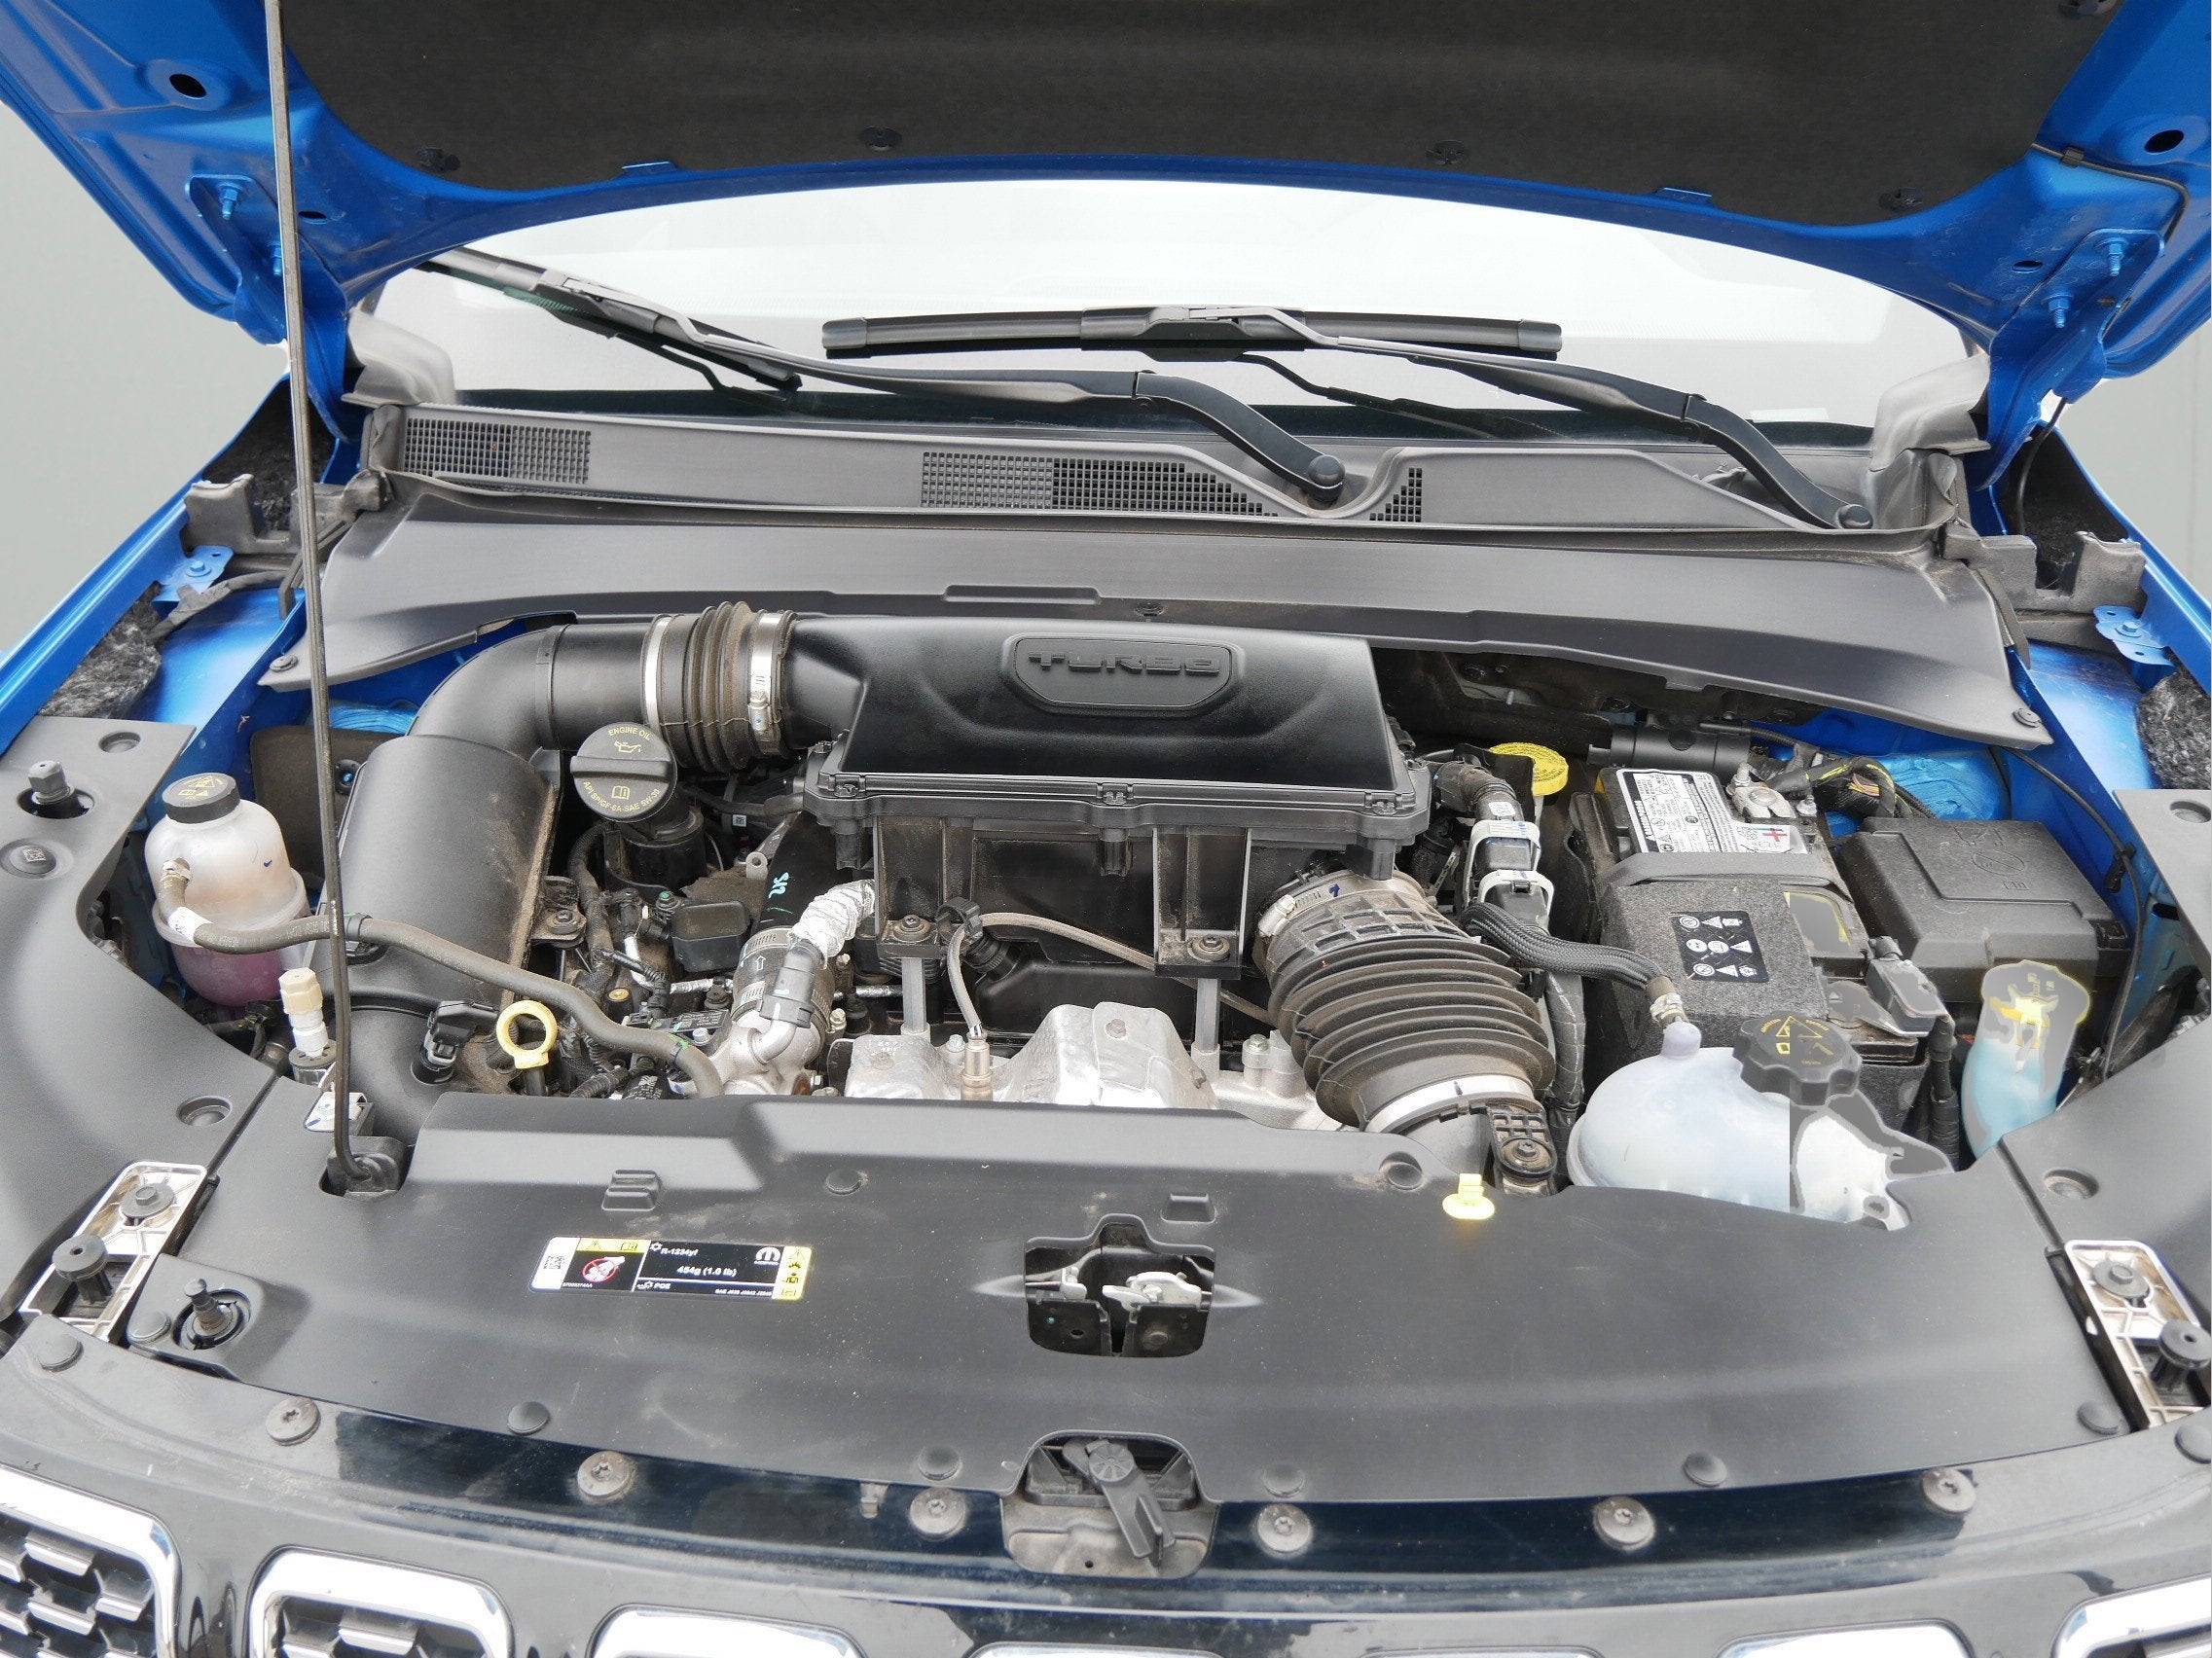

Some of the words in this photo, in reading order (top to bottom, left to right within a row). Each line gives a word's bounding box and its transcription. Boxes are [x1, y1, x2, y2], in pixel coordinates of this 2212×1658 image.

[608, 727, 638, 737] ENGINE
[638, 730, 652, 740] OIL
[584, 781, 595, 795] API
[640, 788, 661, 807] 5W-30
[676, 1266, 702, 1276] 454g
[703, 1267, 722, 1276] (1.0
[723, 1268, 737, 1278] lb)
